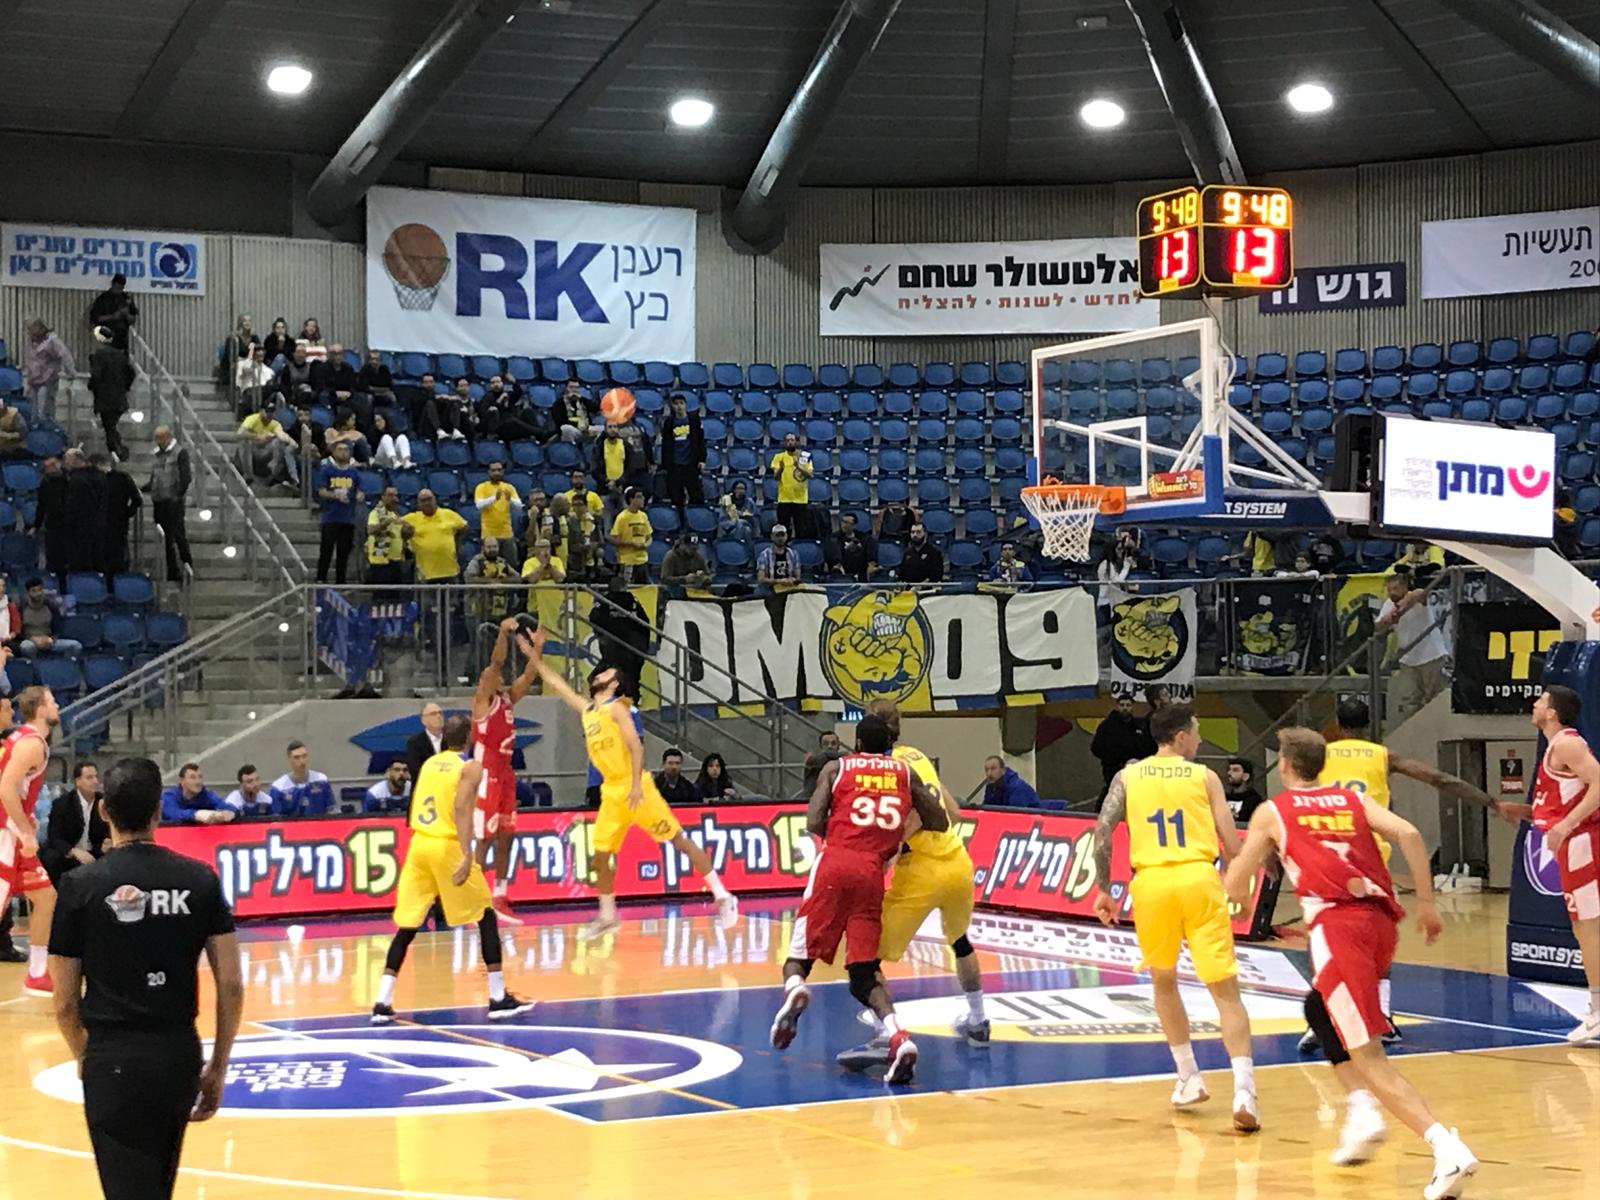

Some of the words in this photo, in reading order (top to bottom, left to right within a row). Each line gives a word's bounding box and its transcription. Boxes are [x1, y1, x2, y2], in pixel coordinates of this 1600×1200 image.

[1153, 192, 1198, 234] 9:48
[1222, 191, 1287, 226] 9:48
[83, 237, 145, 258] דברים
[1160, 229, 1191, 280] 13
[1235, 227, 1277, 278] 13
[1502, 226, 1592, 257] תעשיות
[9, 254, 47, 276] כאן
[456, 232, 610, 324] RK
[611, 245, 682, 284] רענן
[898, 264, 978, 289] שחם
[985, 253, 1139, 287] אלטשולר
[1569, 259, 1600, 279] 20
[898, 293, 977, 310] להצליח
[998, 291, 1062, 310] לשנות
[1316, 271, 1393, 303] גוש
[624, 290, 669, 329] כץ
[1436, 461, 1504, 500] מתן
[418, 796, 437, 825] 3
[850, 796, 902, 830] 35
[1146, 808, 1187, 848] 11
[349, 830, 398, 894] 15
[773, 816, 816, 875] 15
[985, 827, 1070, 895] מיליון
[218, 834, 344, 908] מיליון
[151, 889, 192, 915] RK
[1511, 942, 1585, 967] SPORTSYS
[146, 971, 167, 987] 20
